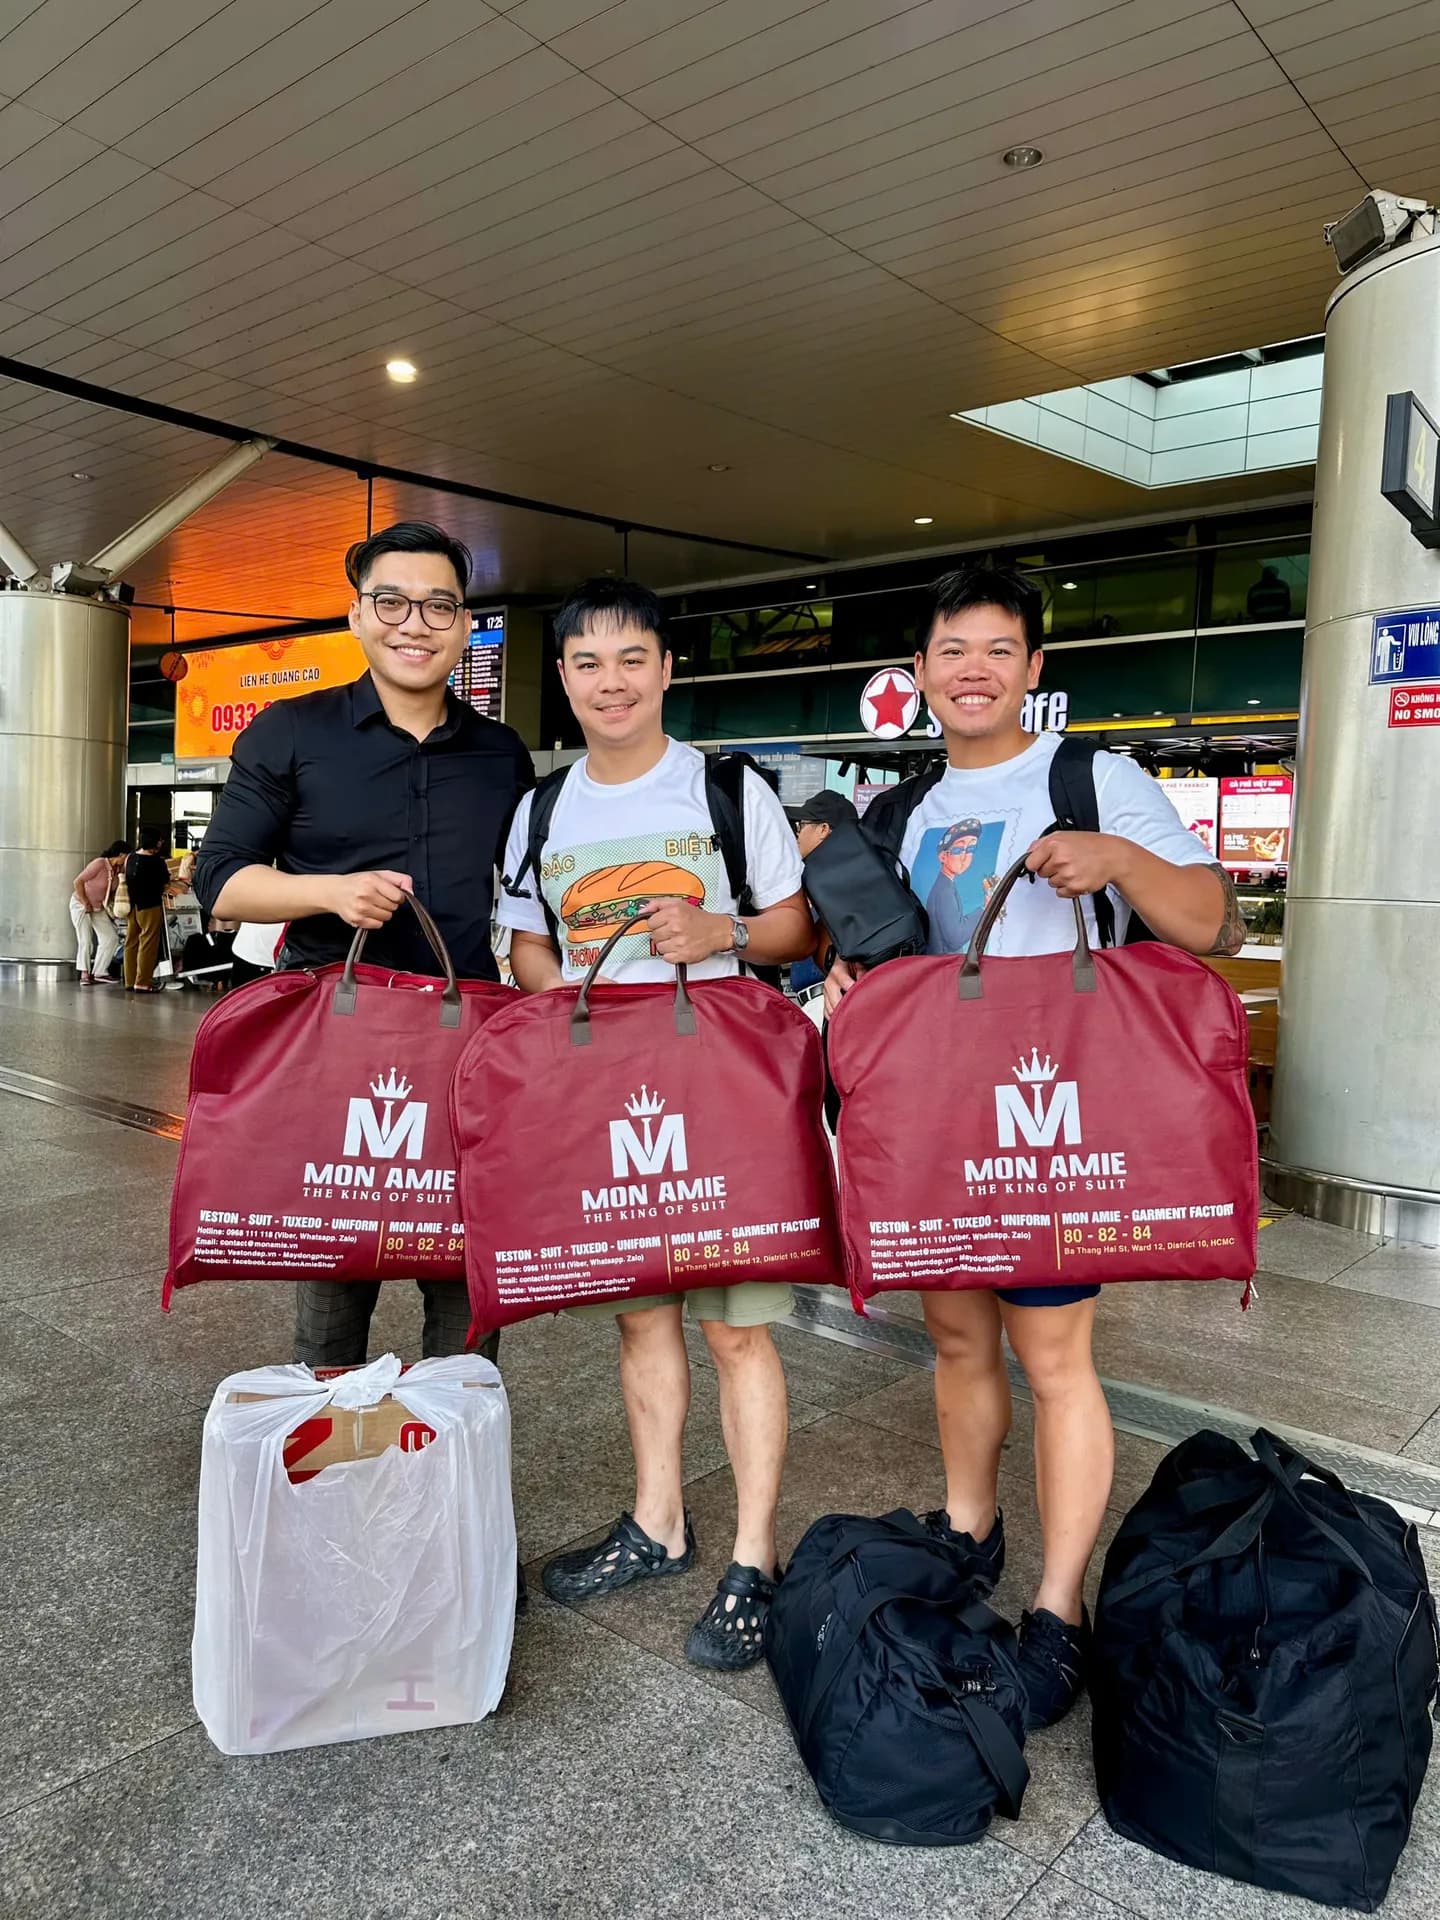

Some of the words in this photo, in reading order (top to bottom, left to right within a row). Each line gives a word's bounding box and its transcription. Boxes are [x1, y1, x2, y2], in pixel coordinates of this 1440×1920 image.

[1020, 691, 1068, 732] afe
[1394, 710, 1410, 720] NO
[1414, 708, 1440, 719] SMO
[665, 832, 712, 861] BIỆT
[964, 1156, 1037, 1182] MON
[1049, 1152, 1127, 1178] AMIE
[304, 1163, 375, 1187] MON
[384, 1168, 456, 1191] AMIE
[303, 1188, 333, 1198] THE
[341, 1190, 381, 1201] KING
[389, 1192, 408, 1201] OF
[417, 1193, 452, 1204] SUIT
[582, 1184, 648, 1210] MON
[658, 1176, 727, 1203] AMIE
[967, 1184, 996, 1196] THE
[1006, 1182, 1048, 1193] KING
[1056, 1181, 1076, 1192] OF
[1086, 1179, 1126, 1190] SUIT
[200, 1210, 238, 1224] VESTON
[249, 1213, 272, 1226] SUIT
[282, 1215, 321, 1228] TUXEDO
[332, 1218, 378, 1232] UNIFORM
[584, 1212, 612, 1224] THE
[620, 1208, 657, 1220] KING
[665, 1204, 684, 1215] OF
[692, 1200, 726, 1212] SUIT
[1062, 1213, 1088, 1225] MON
[1092, 1211, 1121, 1223] AMIE
[1132, 1207, 1186, 1221] GARMENT
[198, 1227, 224, 1236] Hotline:
[246, 1229, 258, 1238] 111
[389, 1221, 414, 1233] MON
[416, 1222, 442, 1233] AMIE
[672, 1233, 694, 1245] MON
[698, 1229, 722, 1243] AMIE
[732, 1223, 779, 1239] GARMENT
[781, 1218, 820, 1233] FACTORY
[870, 1221, 909, 1234] VESTON
[919, 1219, 942, 1232] SUIT
[952, 1215, 991, 1229] TUXEDO
[1002, 1215, 1050, 1226] UNIFORM
[196, 1238, 218, 1246] Email:
[919, 1236, 931, 1244] 111
[1064, 1228, 1082, 1243] 80
[1098, 1227, 1117, 1242] 82
[1133, 1225, 1152, 1240] 84
[386, 1237, 403, 1250] 80
[417, 1238, 434, 1251] 82
[448, 1238, 464, 1251] 84
[495, 1249, 531, 1262] VESTON
[541, 1245, 562, 1258] SUIT
[571, 1241, 608, 1255] TUXEDO
[617, 1236, 661, 1251] UNIFORM
[674, 1248, 690, 1262] 80
[704, 1245, 720, 1258] 82
[734, 1241, 750, 1255] 84
[1077, 1247, 1101, 1255] Thang
[1167, 1240, 1195, 1250] District
[1211, 1237, 1235, 1246] HCMC
[764, 1254, 788, 1263] District
[801, 1249, 820, 1258] HCMC
[871, 1250, 894, 1258] Email:
[541, 1262, 552, 1270] 111
[497, 1276, 518, 1284] Email:
[873, 1272, 909, 1280] Facebook:
